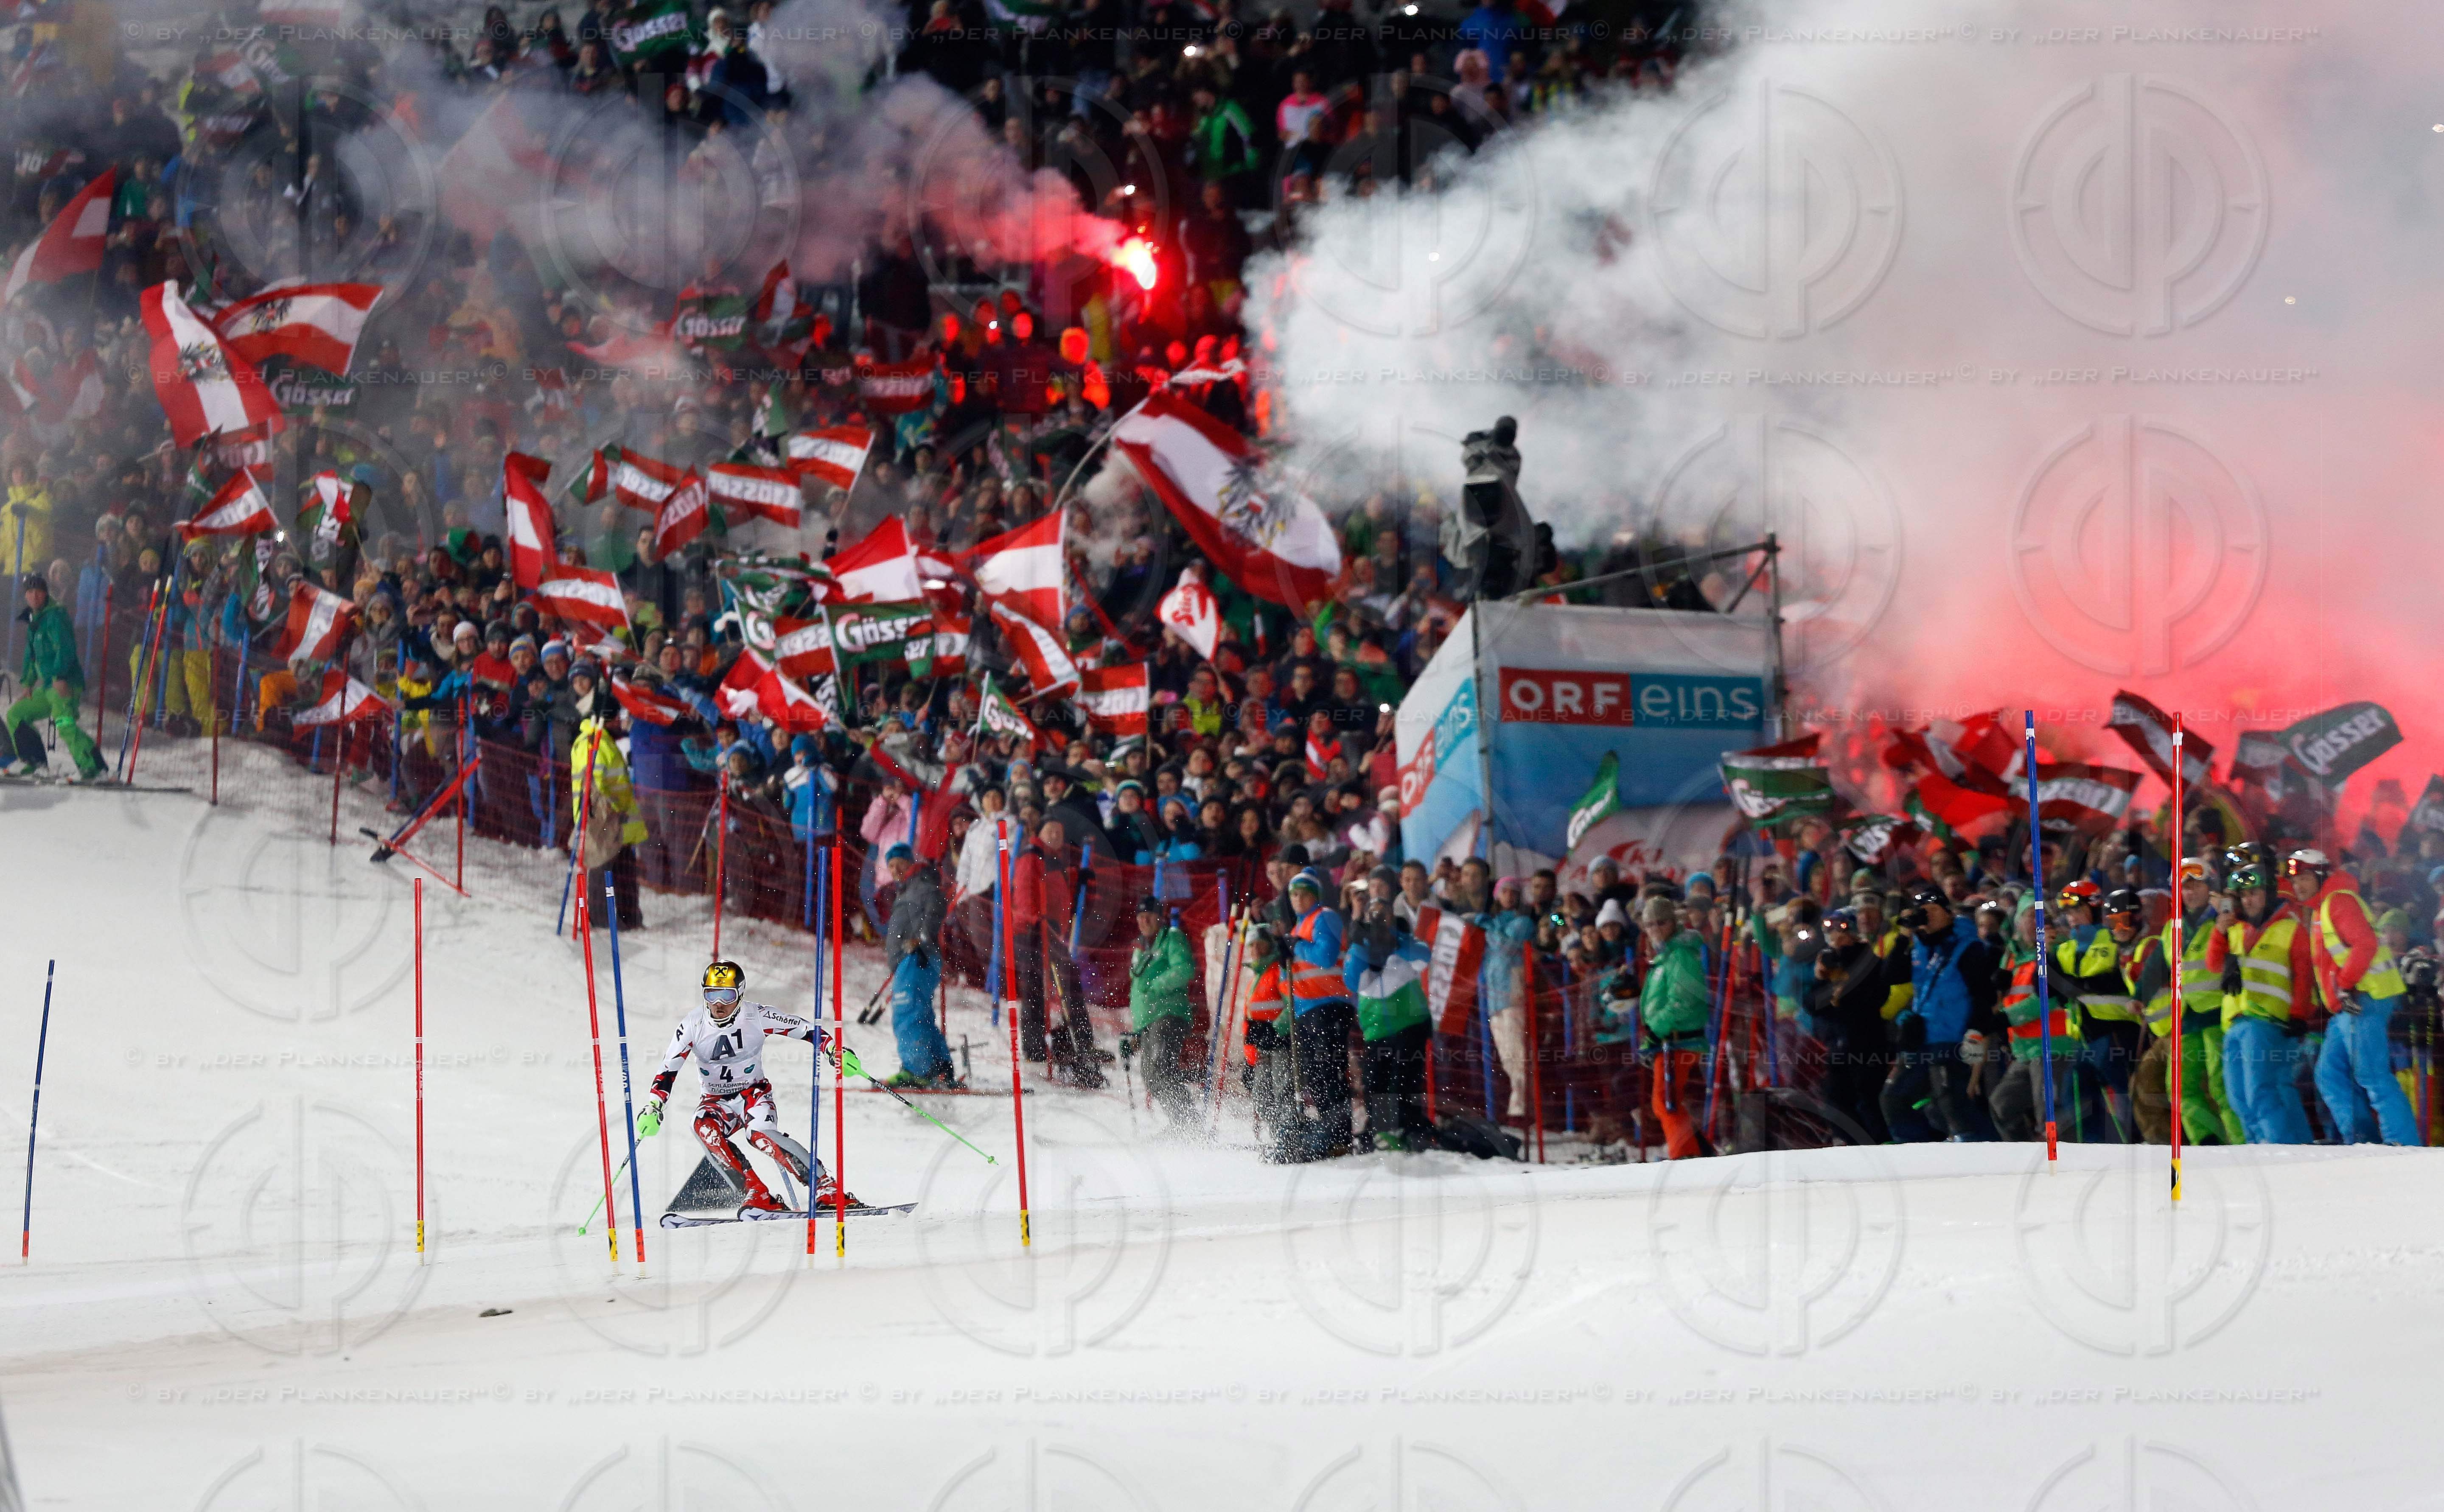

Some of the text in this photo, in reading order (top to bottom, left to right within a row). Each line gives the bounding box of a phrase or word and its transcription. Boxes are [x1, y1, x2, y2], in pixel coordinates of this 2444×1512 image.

[1509, 678, 1759, 721] ORF eins
[771, 1012, 801, 1026] Schöffel
[711, 1028, 743, 1061] A1
[720, 1066, 734, 1083] 4
